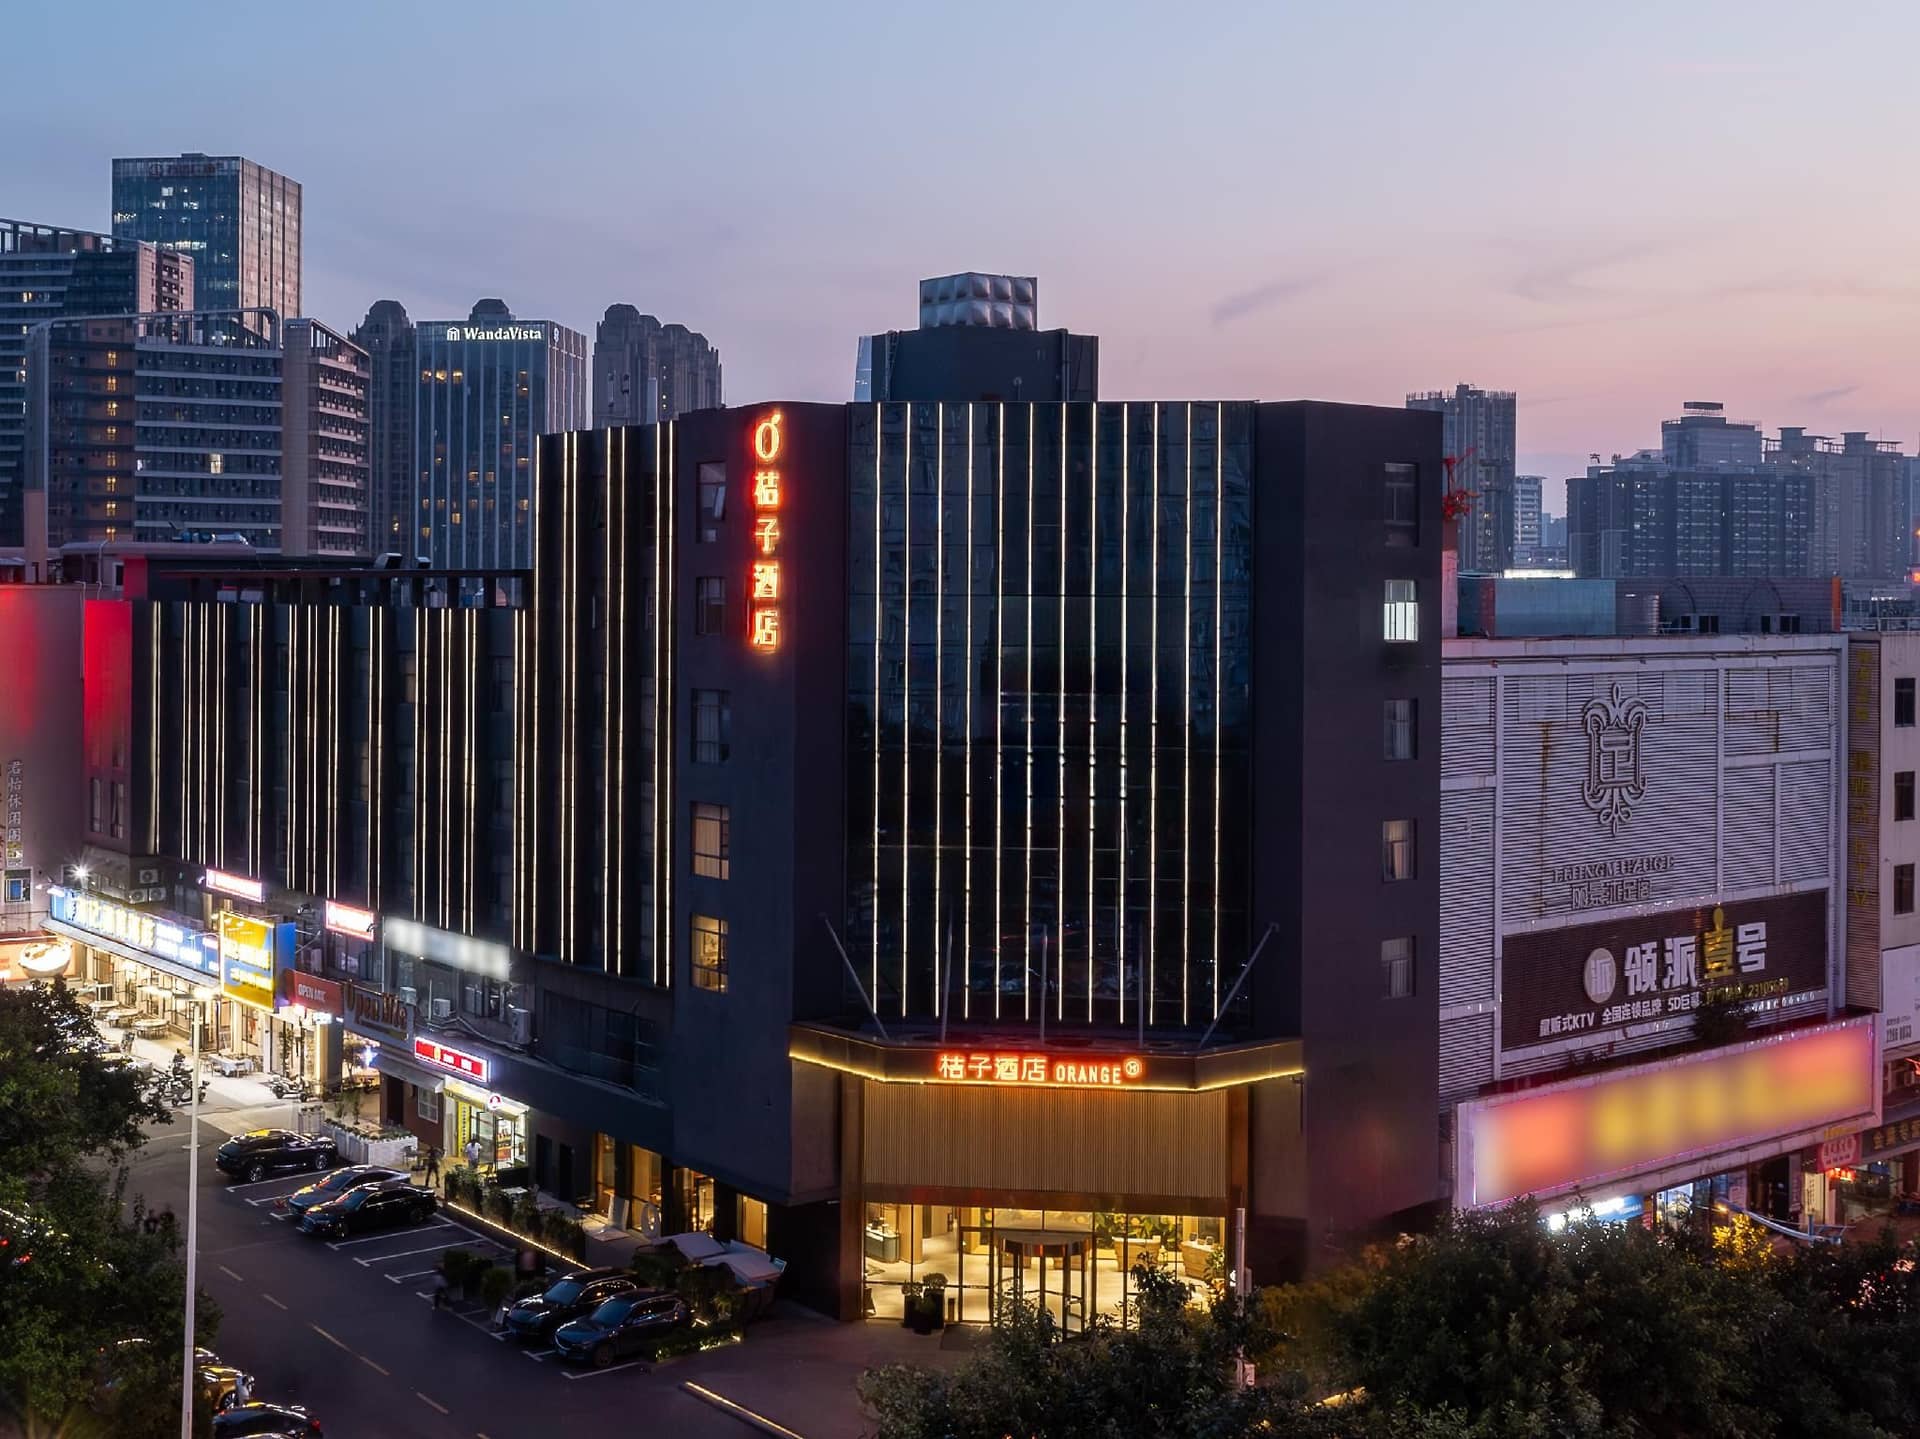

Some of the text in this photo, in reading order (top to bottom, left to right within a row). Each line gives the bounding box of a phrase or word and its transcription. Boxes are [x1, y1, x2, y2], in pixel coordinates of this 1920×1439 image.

[463, 327, 542, 340] WandaVista
[754, 471, 780, 648] 桔子酒店
[1601, 998, 1662, 1025] 全国连锁品牌
[939, 1055, 1047, 1082] 桔子酒店
[1055, 1064, 1122, 1084] ORANGE
